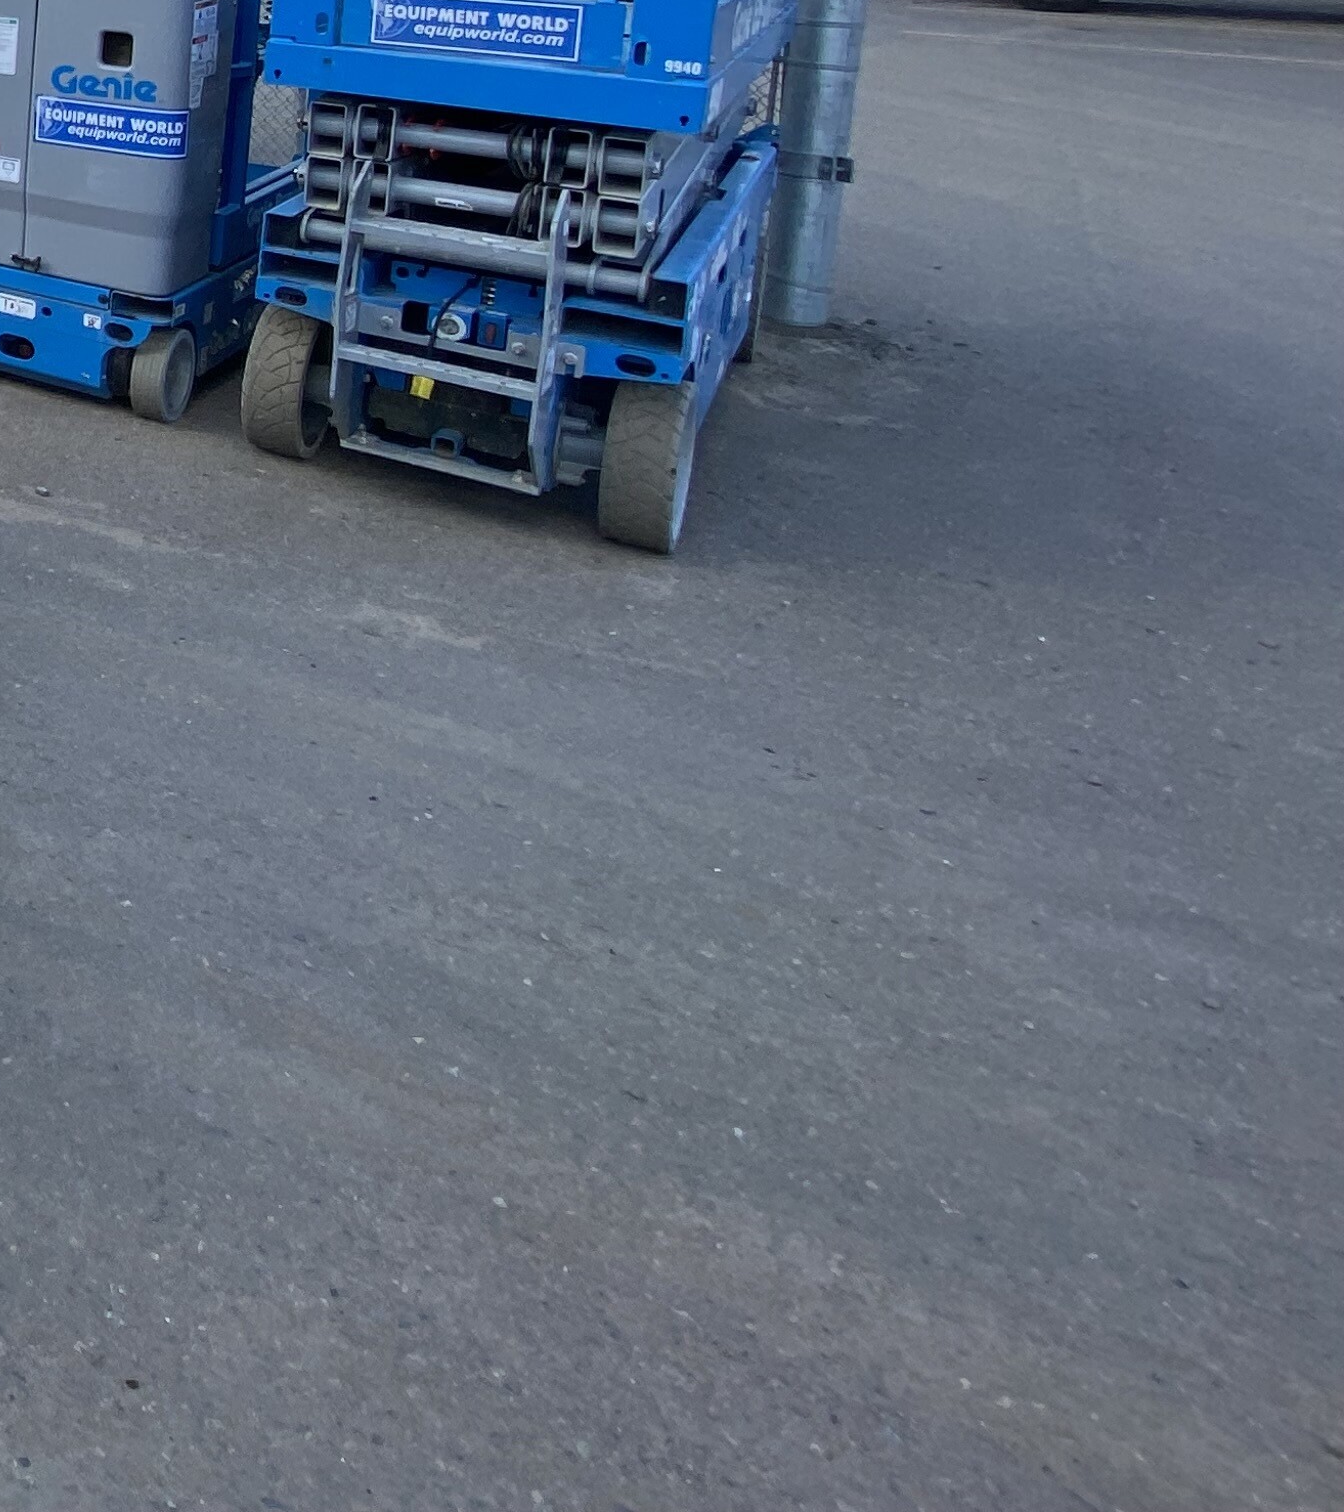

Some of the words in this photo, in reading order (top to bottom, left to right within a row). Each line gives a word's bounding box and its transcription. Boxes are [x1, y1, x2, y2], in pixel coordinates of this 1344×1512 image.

[384, 4, 490, 25] EQUIPMENT
[497, 13, 569, 32] WORLD
[413, 24, 564, 47] equipworld.com
[51, 64, 157, 103] Genie
[45, 107, 125, 129] EQUIPMENT
[130, 118, 184, 135] WORLD
[67, 124, 181, 147] equipworld.com
